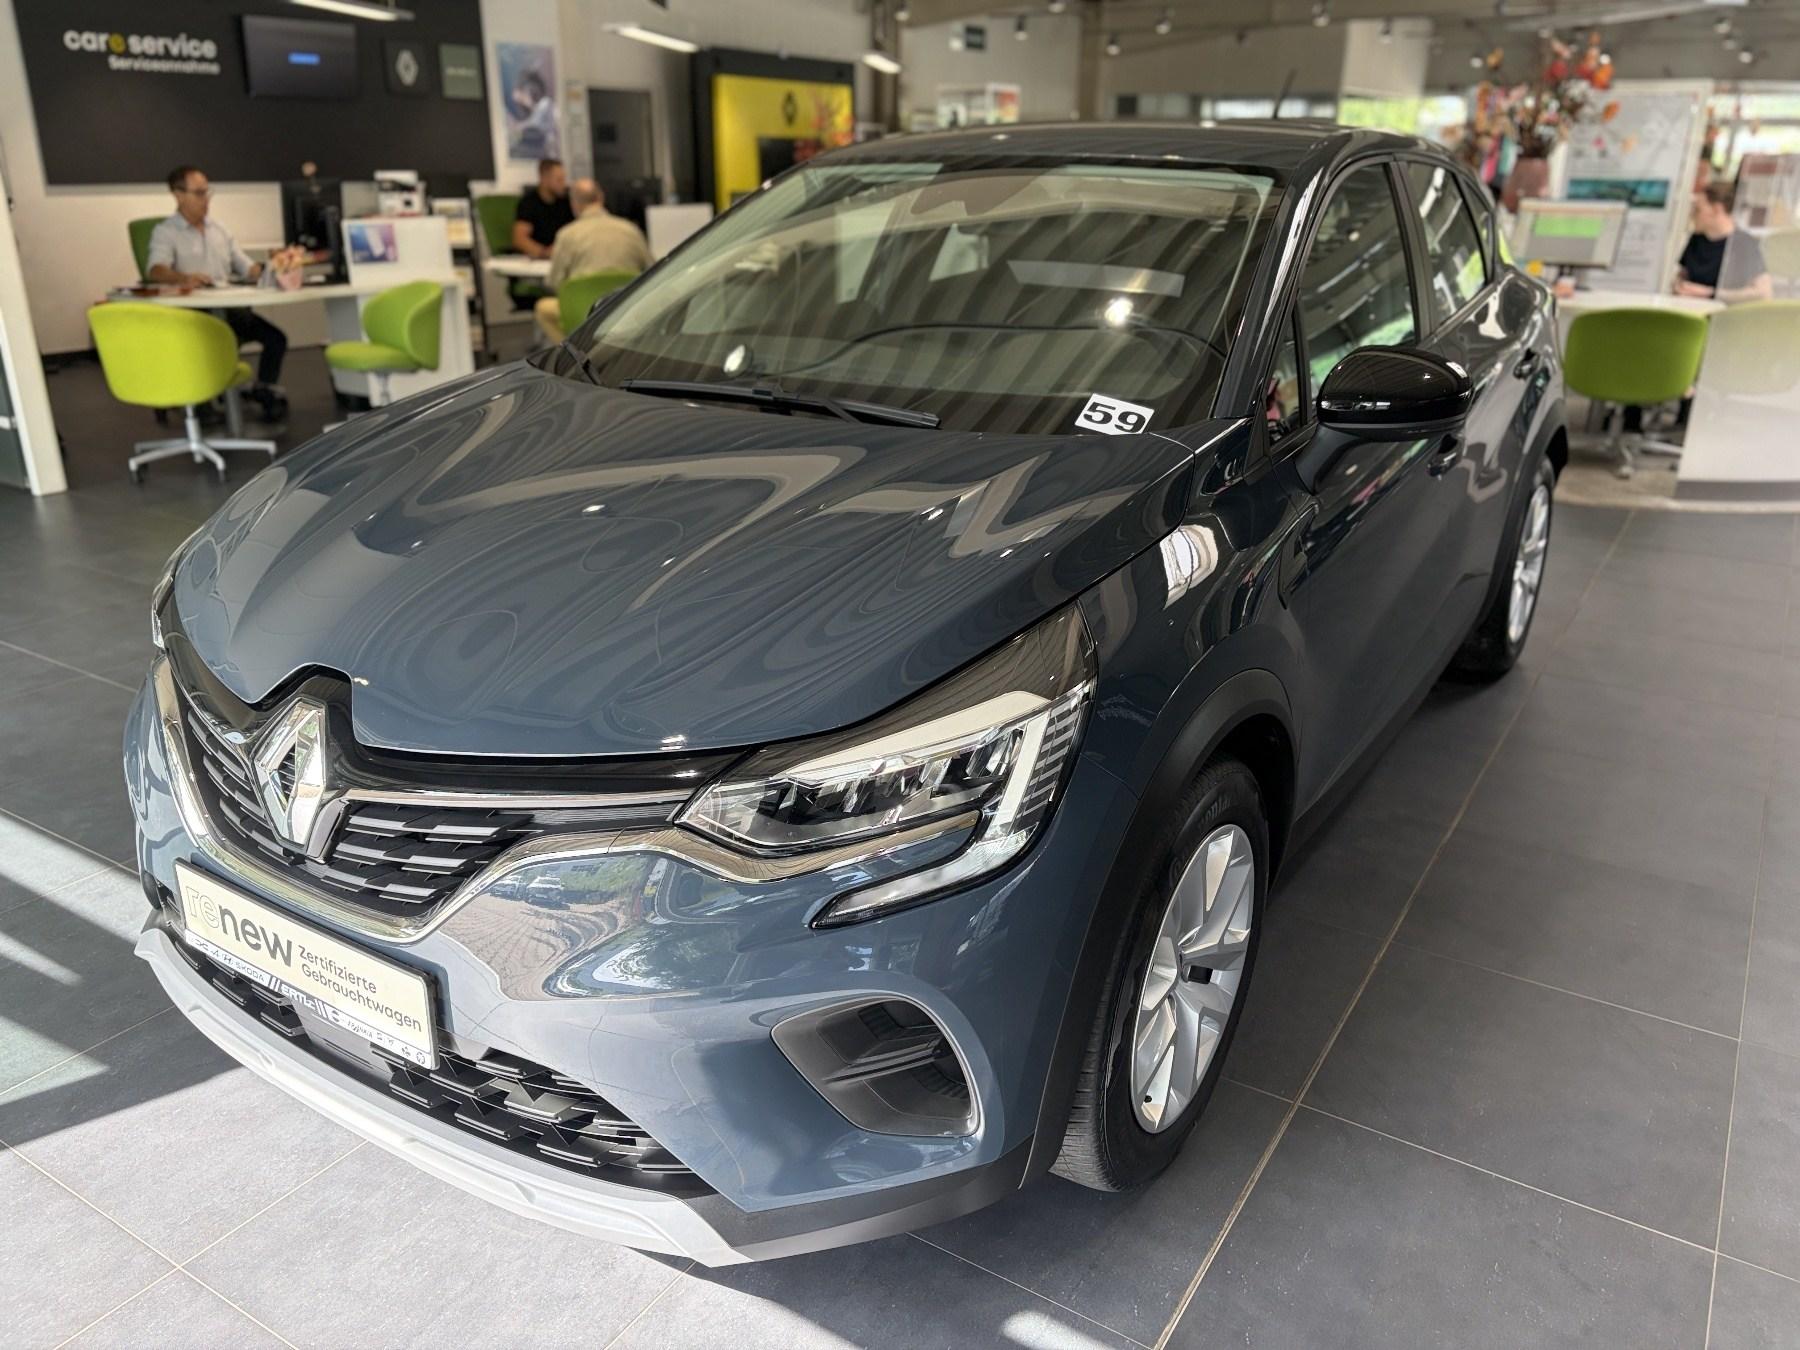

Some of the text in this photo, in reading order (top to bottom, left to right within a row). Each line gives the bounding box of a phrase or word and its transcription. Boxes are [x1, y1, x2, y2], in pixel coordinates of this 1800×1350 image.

[128, 33, 218, 59] service
[1083, 402, 1146, 433] 59
[298, 944, 378, 994] Zertifizierte
[301, 963, 423, 1033] Gebrauchtwagen
